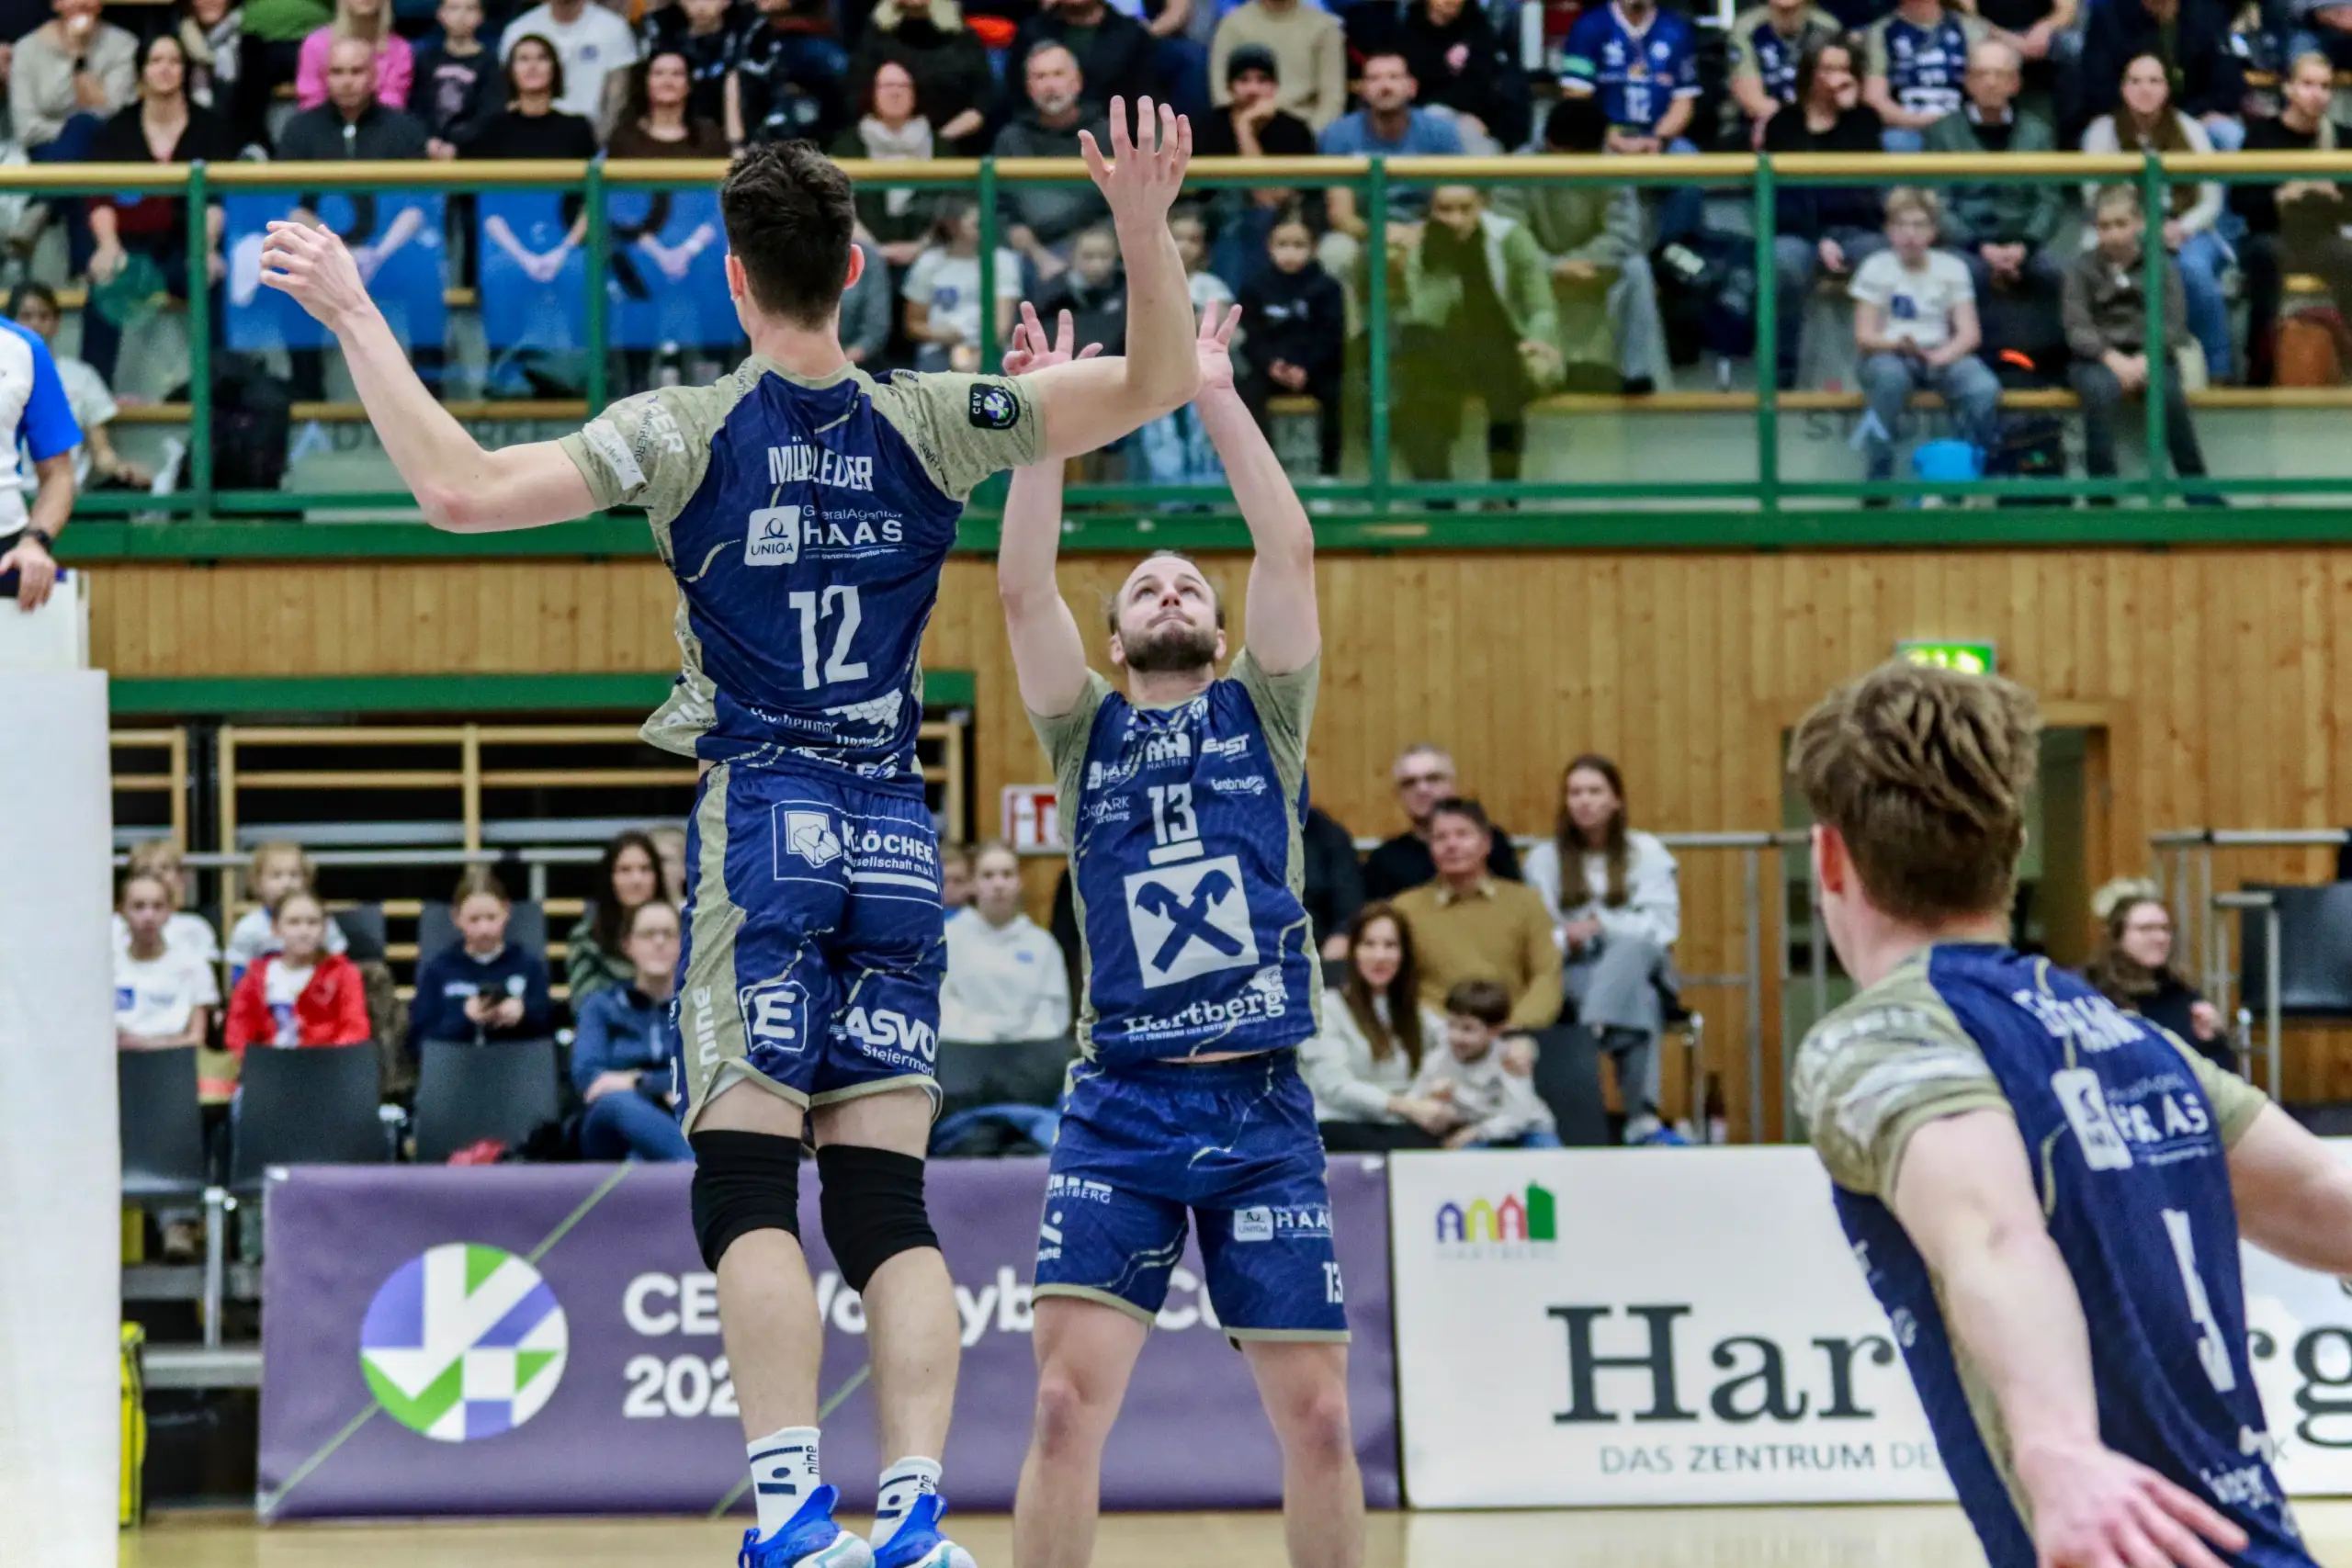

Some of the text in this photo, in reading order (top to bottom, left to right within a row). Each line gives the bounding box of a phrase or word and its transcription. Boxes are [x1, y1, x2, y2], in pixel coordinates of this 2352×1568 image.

[972, 392, 982, 415] CEV
[751, 542, 794, 556] UNIQA
[803, 519, 903, 547] HAAS
[788, 585, 869, 690] 12
[1147, 783, 1199, 846] 13
[752, 990, 797, 1040] E
[1122, 991, 1286, 1035] Hartberg
[623, 1271, 723, 1337] CE
[803, 1445, 820, 1476] nine
[1599, 1444, 1673, 1474] DAS
[1688, 1442, 1875, 1472] ZENTRUM
